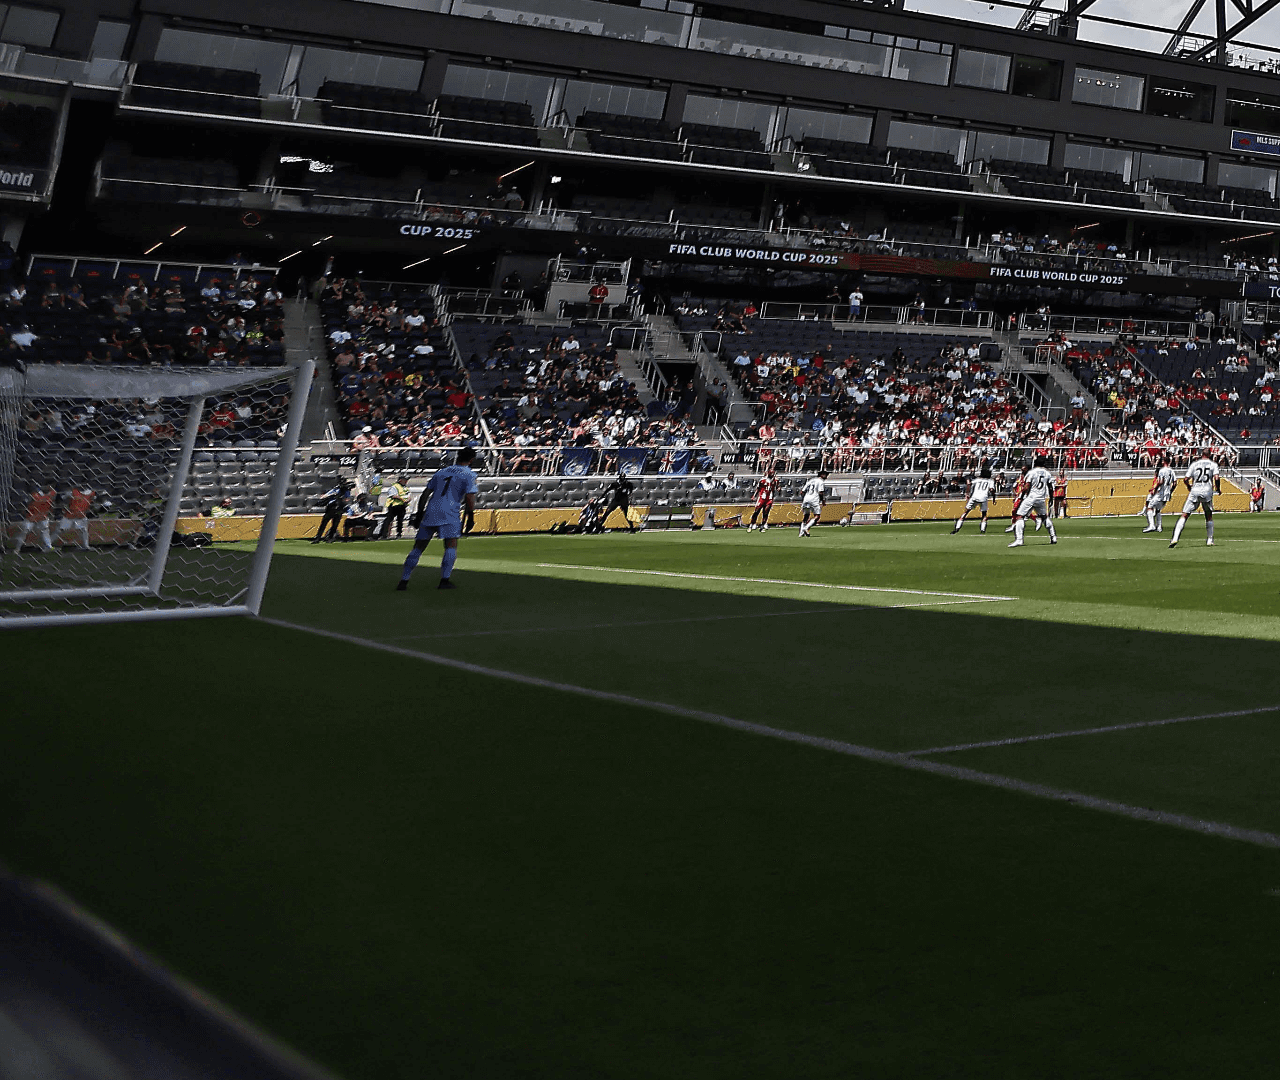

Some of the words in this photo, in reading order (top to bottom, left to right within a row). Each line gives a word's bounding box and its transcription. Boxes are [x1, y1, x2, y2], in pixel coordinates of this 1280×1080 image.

[1256, 136, 1268, 145] MLS
[0, 170, 34, 187] orld
[400, 224, 432, 236] CUP
[669, 244, 697, 255] FIFA
[700, 246, 732, 258] CLUB
[735, 248, 780, 261] WORLD
[782, 252, 807, 263] CUP
[990, 267, 1012, 277] FIFA
[1014, 269, 1039, 279] CLUB
[1042, 271, 1077, 281] WORLD
[1079, 274, 1098, 283] CUP
[723, 454, 736, 463] W1
[743, 454, 756, 463] W2
[1195, 468, 1211, 483] 25
[441, 476, 453, 497] 1
[976, 481, 989, 491] 10
